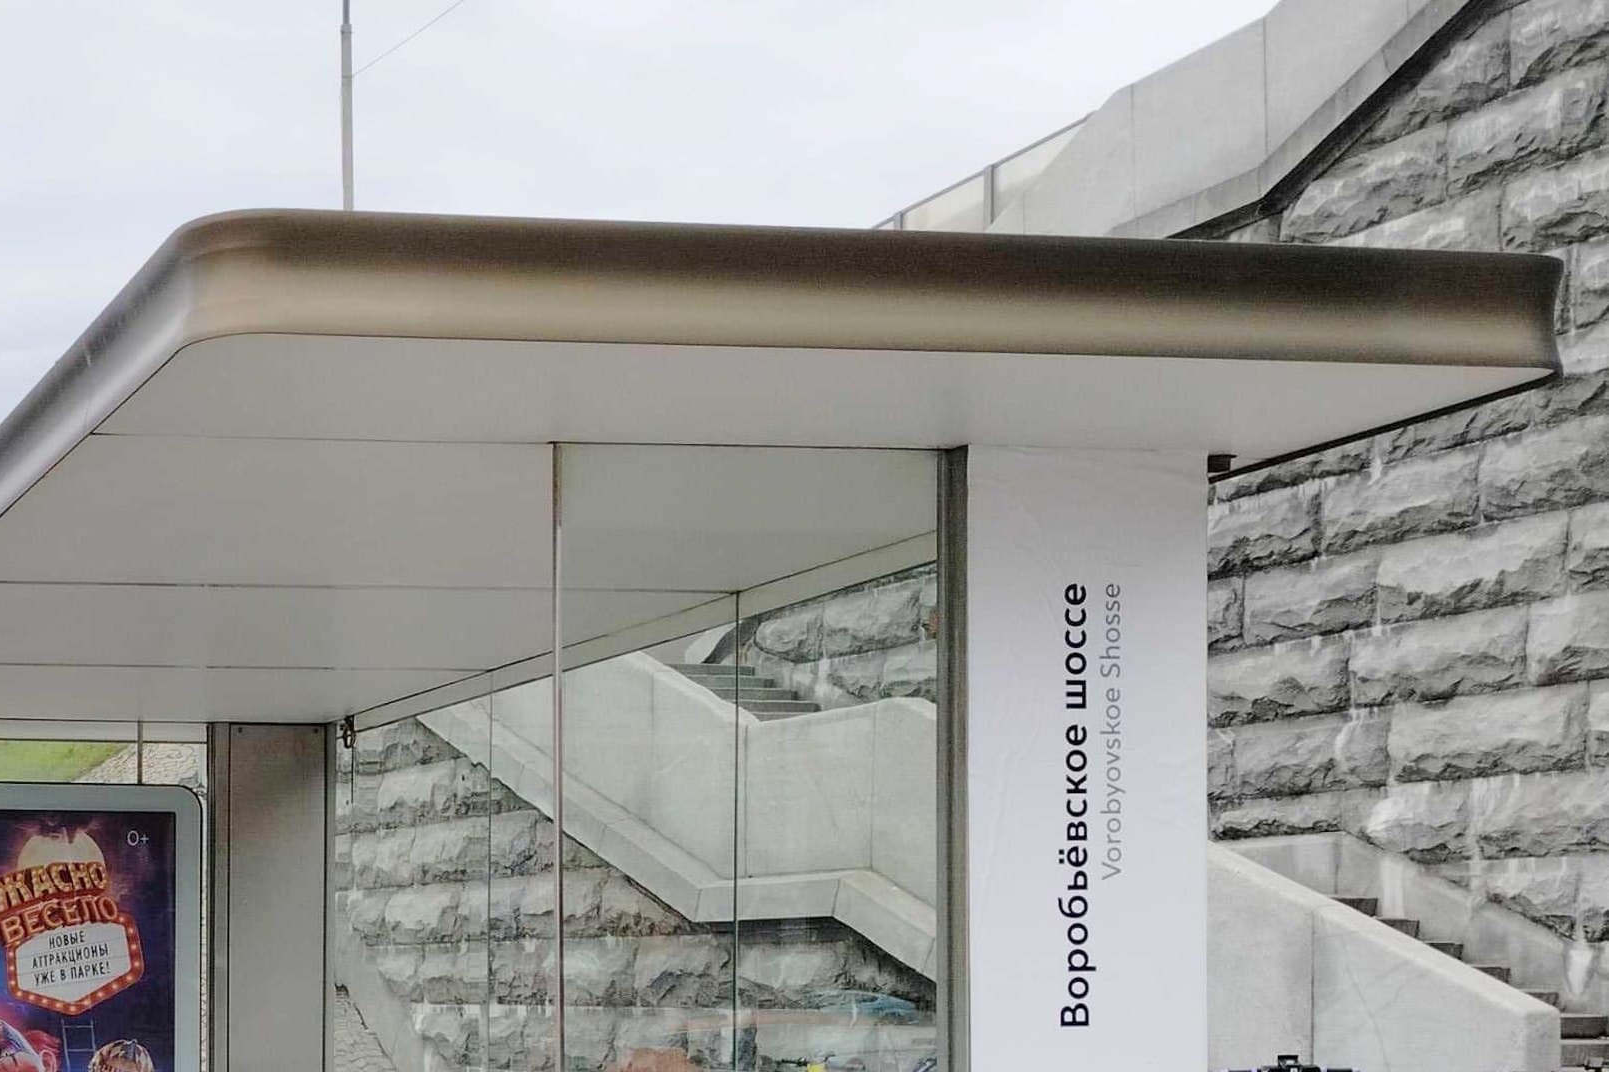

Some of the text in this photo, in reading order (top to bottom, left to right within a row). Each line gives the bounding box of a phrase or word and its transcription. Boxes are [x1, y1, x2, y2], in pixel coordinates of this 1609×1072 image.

[1100, 583, 1126, 880] Vorobyovskoe Shosse
[1058, 583, 1096, 1027] Воробьёвское шоссе
[127, 830, 149, 847] 0+
[1, 896, 118, 944] ВЕСЕЛО
[49, 931, 85, 949] НОВЫЕ
[32, 943, 109, 969] АТТРАКЦИОНЫ
[33, 961, 111, 986] УЖЕ В ПАРКЕ!
